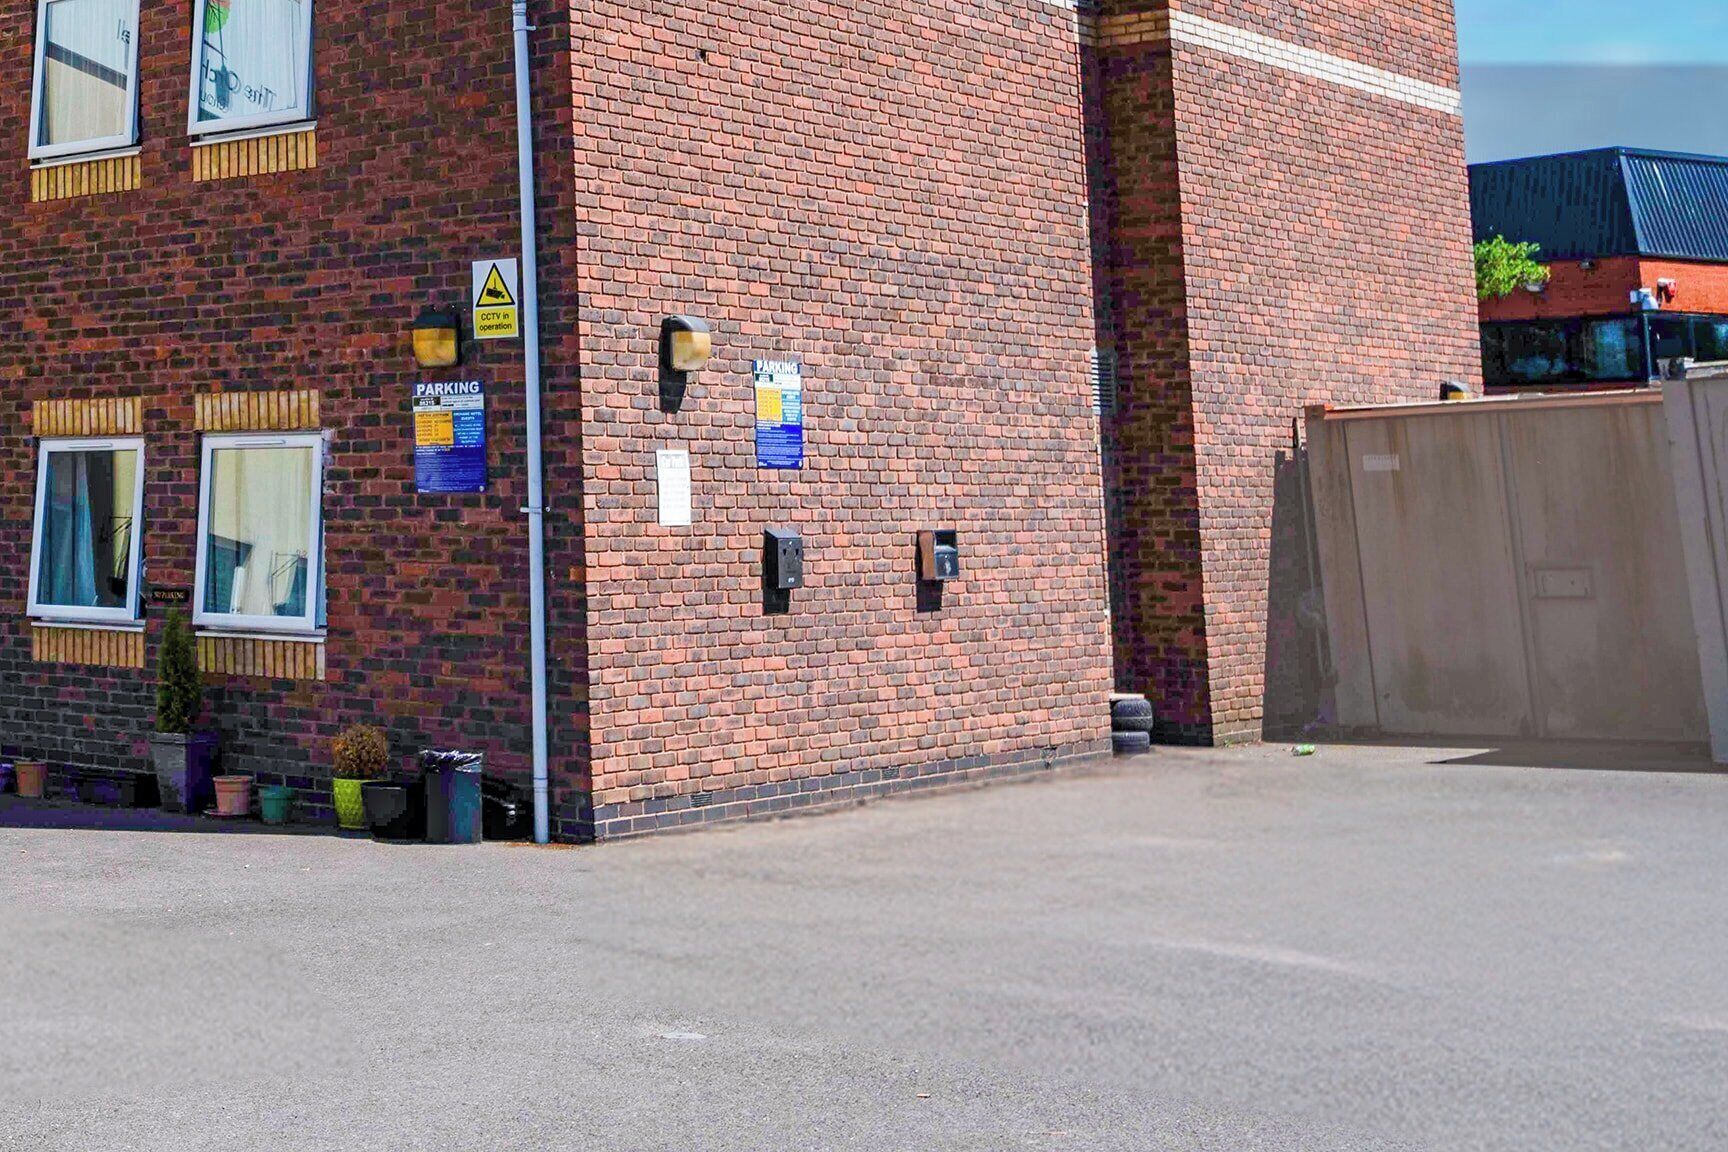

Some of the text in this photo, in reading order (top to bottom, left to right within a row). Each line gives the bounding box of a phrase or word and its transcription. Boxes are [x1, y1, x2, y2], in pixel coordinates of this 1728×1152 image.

[480, 312, 510, 321] CCTV in
[479, 323, 513, 332] operation
[756, 360, 798, 374] PARKING
[416, 381, 480, 396] PARKING
